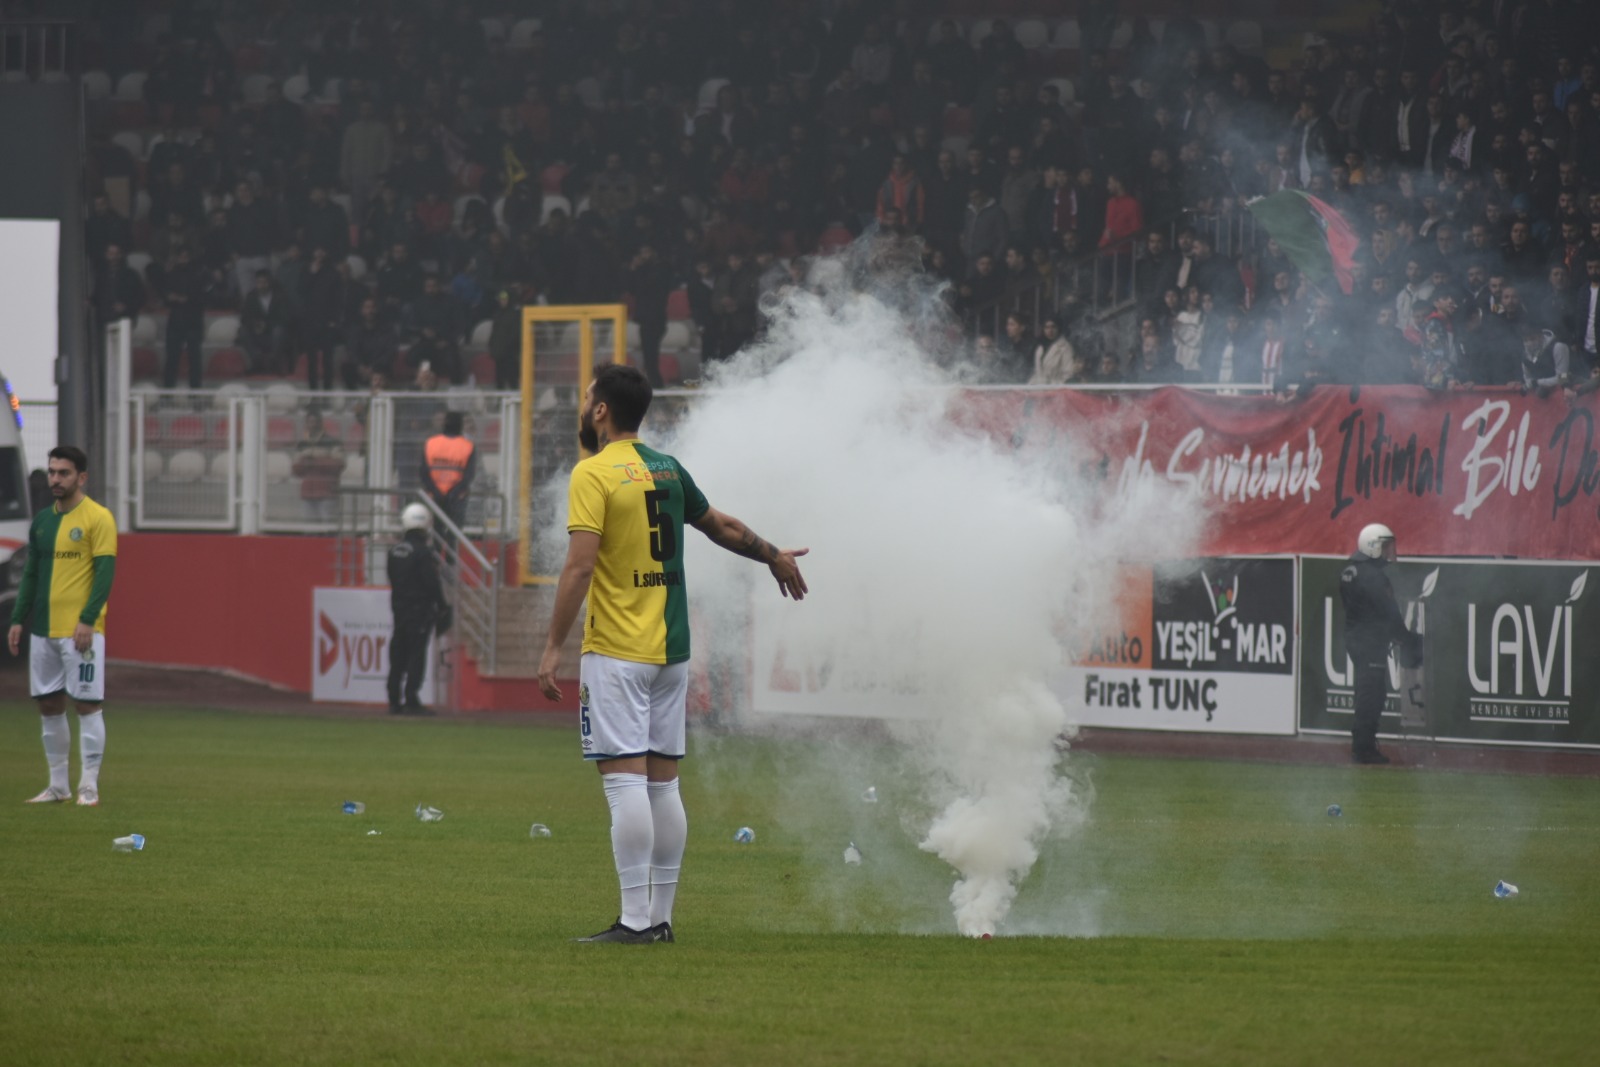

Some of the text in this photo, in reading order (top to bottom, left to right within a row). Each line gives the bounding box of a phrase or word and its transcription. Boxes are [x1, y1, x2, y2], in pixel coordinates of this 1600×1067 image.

[1453, 398, 1541, 520] Bile
[1549, 407, 1600, 520] De
[644, 489, 676, 562] 5
[1087, 631, 1143, 664] Auto
[78, 663, 95, 682] 10
[1084, 674, 1219, 723] Fırat TUNÇ
[1548, 706, 1570, 719] BAK
[581, 706, 592, 737] 5
